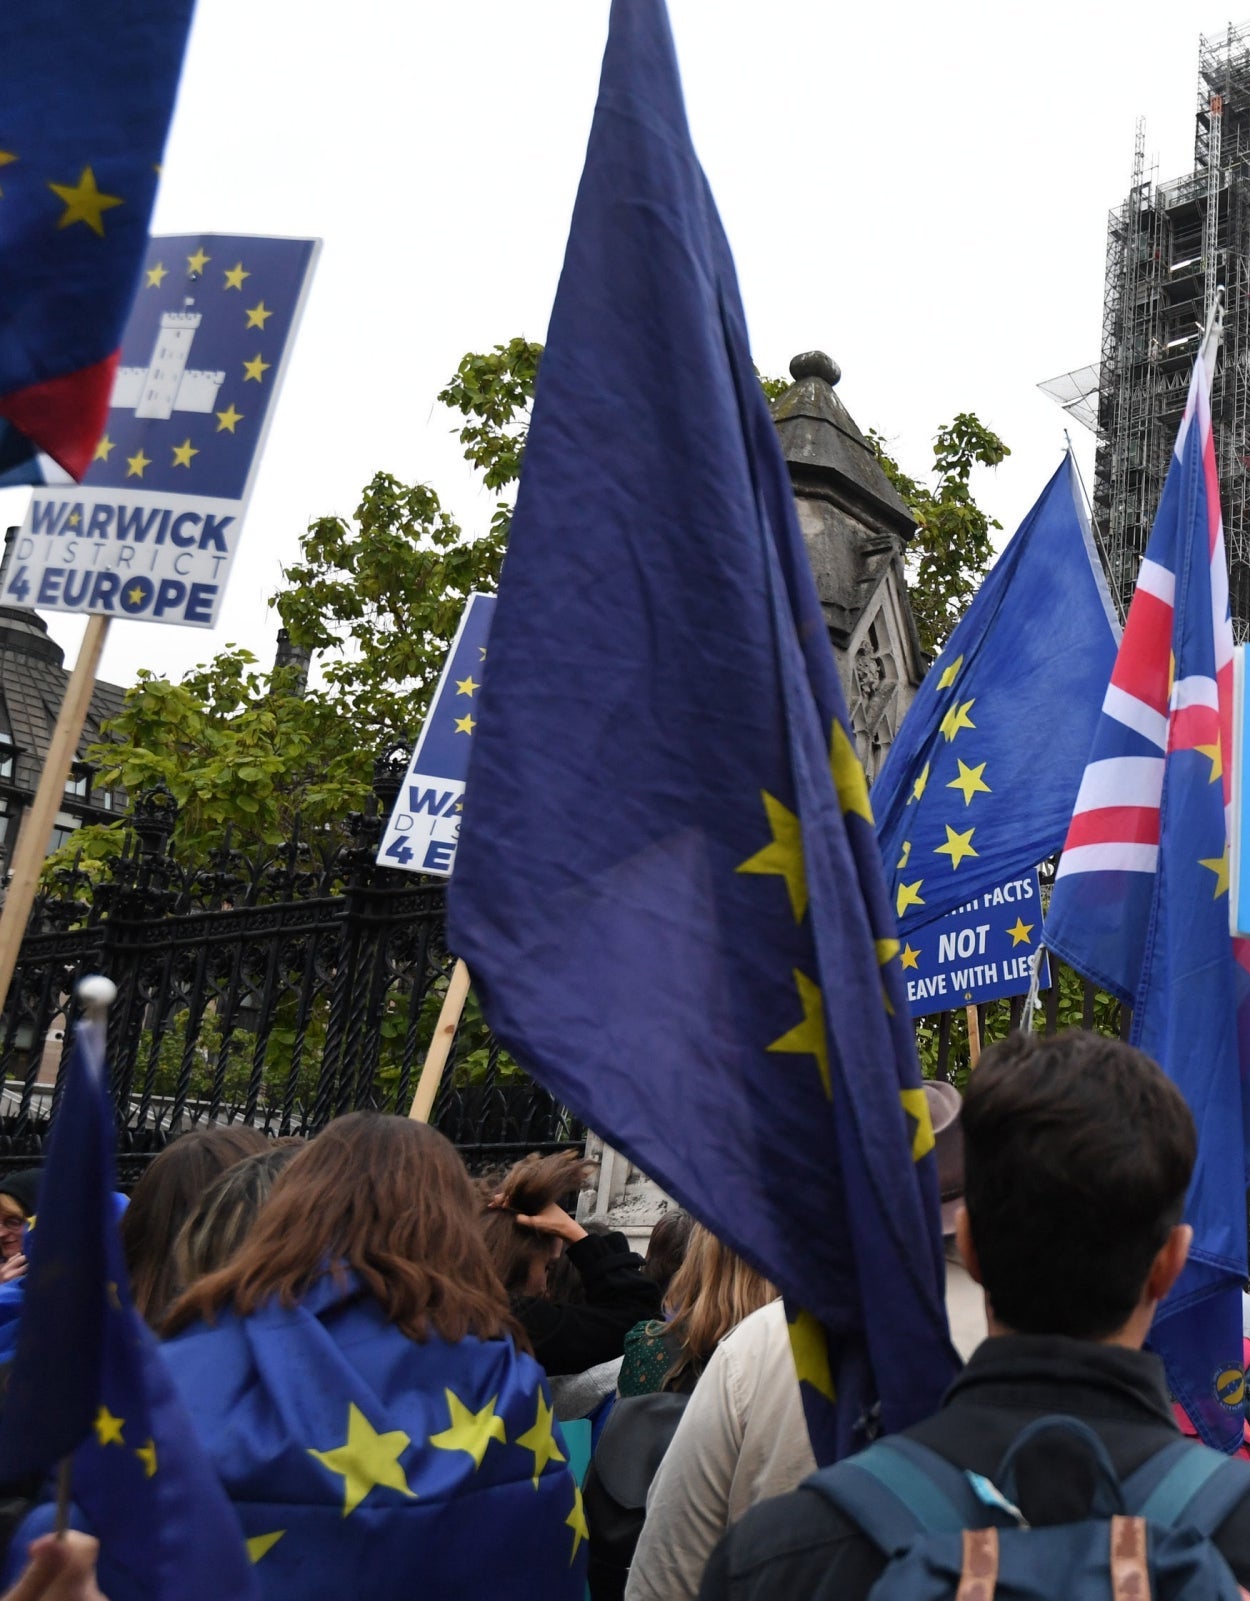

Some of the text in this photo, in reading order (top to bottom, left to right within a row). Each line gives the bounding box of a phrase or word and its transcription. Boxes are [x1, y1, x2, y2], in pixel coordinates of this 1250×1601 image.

[31, 500, 236, 552] WARWICK
[16, 538, 227, 579] DISTRICT
[7, 566, 219, 624] 4 EUROPE
[385, 835, 414, 865] 4
[938, 924, 990, 963] NOT
[907, 954, 1035, 1001] EAVE WITH LIES
